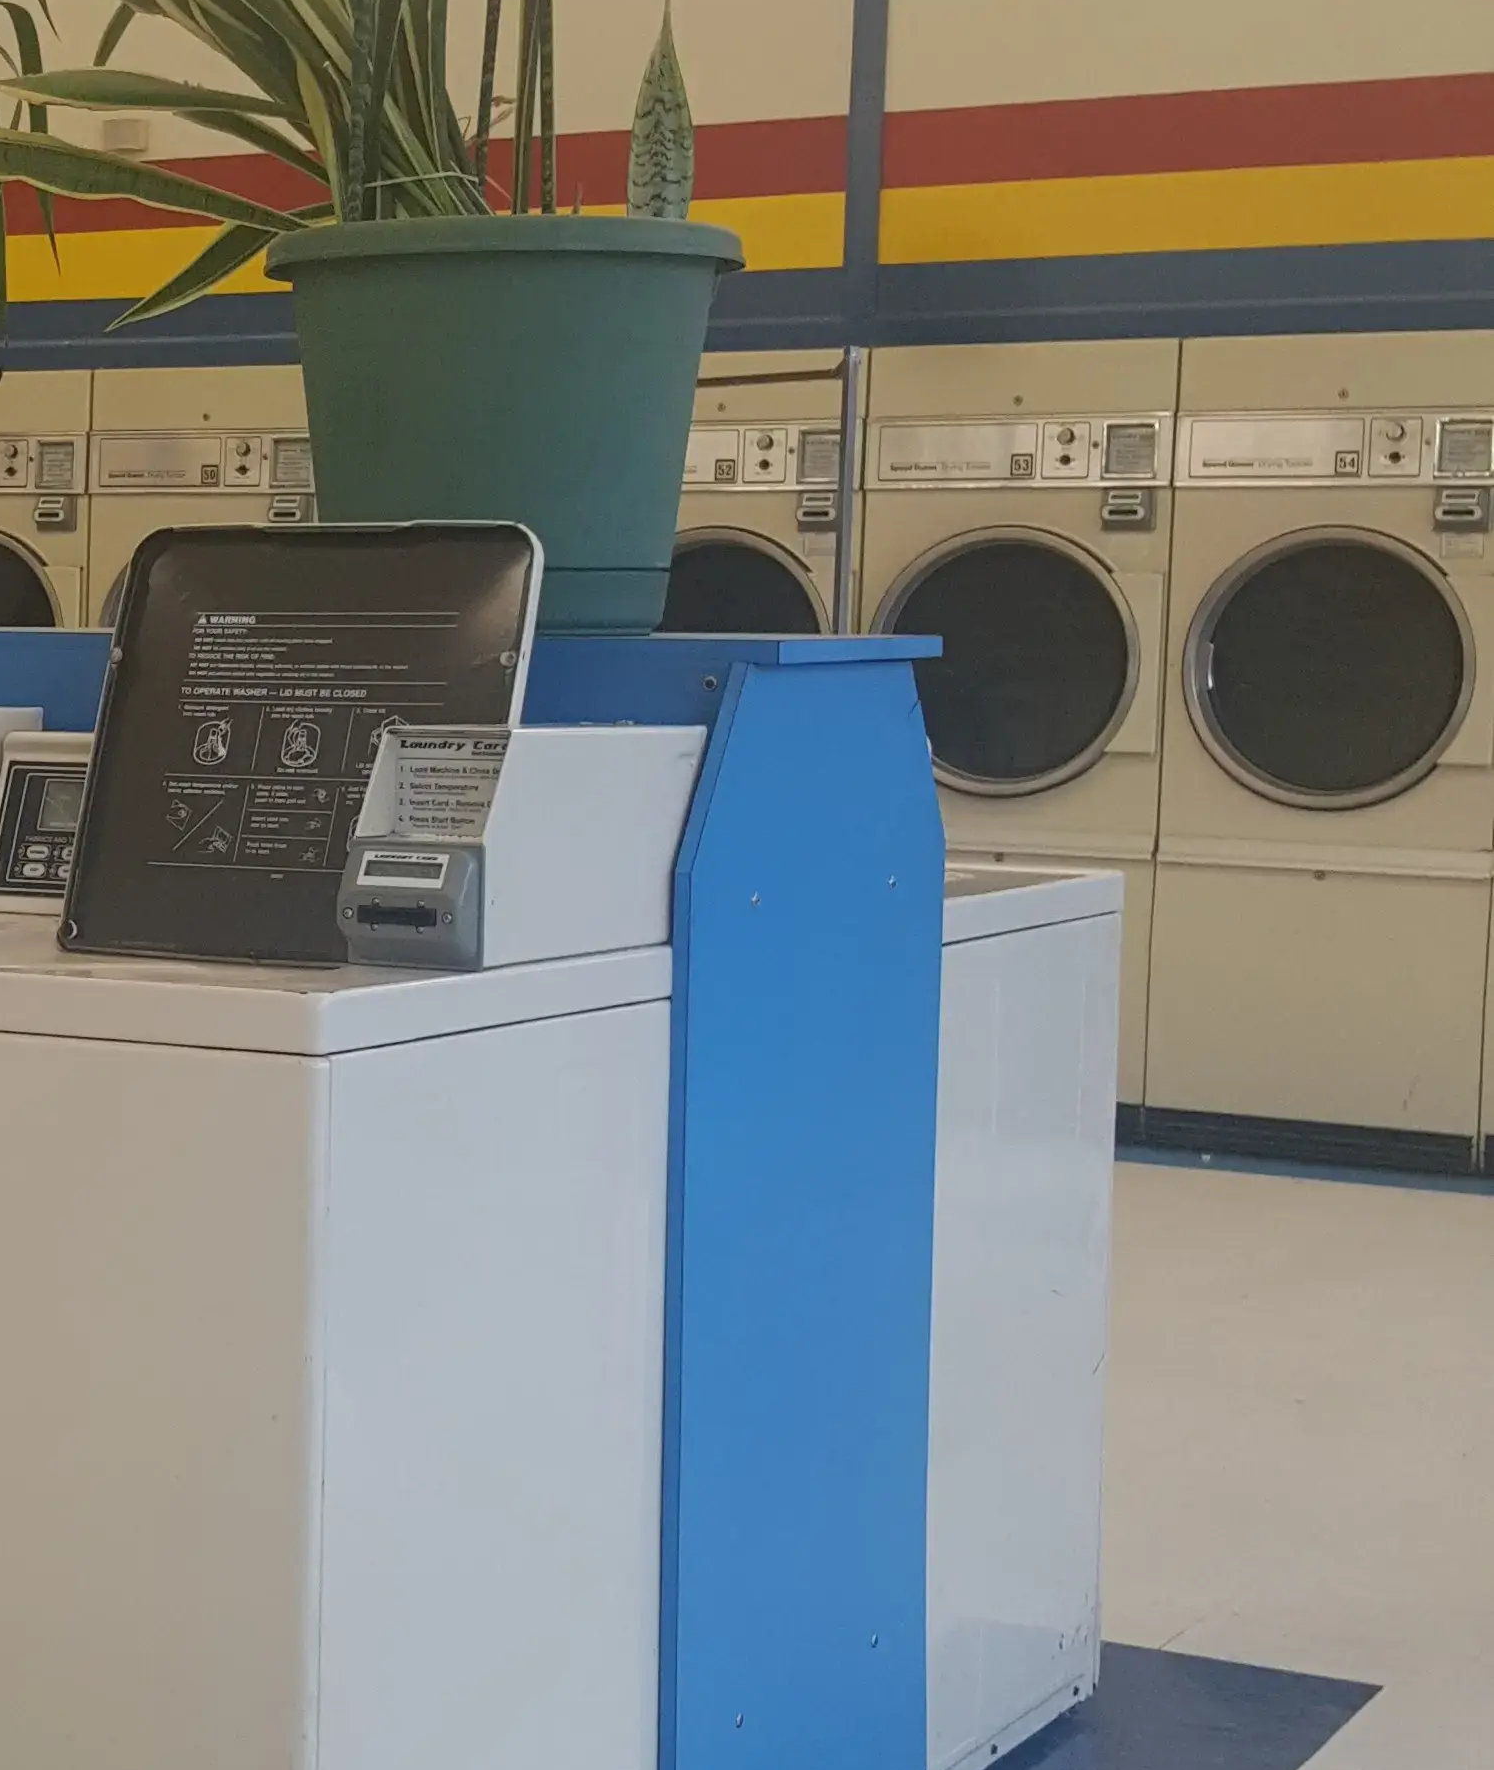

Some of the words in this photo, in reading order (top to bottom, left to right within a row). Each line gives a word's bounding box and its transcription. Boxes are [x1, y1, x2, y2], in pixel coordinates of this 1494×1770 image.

[1014, 458, 1030, 472] 53
[1338, 456, 1356, 469] 54
[204, 469, 216, 480] 50
[717, 464, 732, 476] 52
[209, 615, 257, 625] WARNING
[181, 686, 192, 695] TO
[193, 687, 231, 696] OPERATE
[233, 688, 267, 697] WASHER
[280, 689, 293, 697] LID
[295, 689, 317, 698] MUST
[319, 690, 331, 698] BE
[333, 690, 367, 698] CLOSED
[400, 740, 466, 751] Laundry
[429, 766, 460, 774] Machine
[434, 783, 479, 792] Temperature
[432, 799, 449, 807] Card
